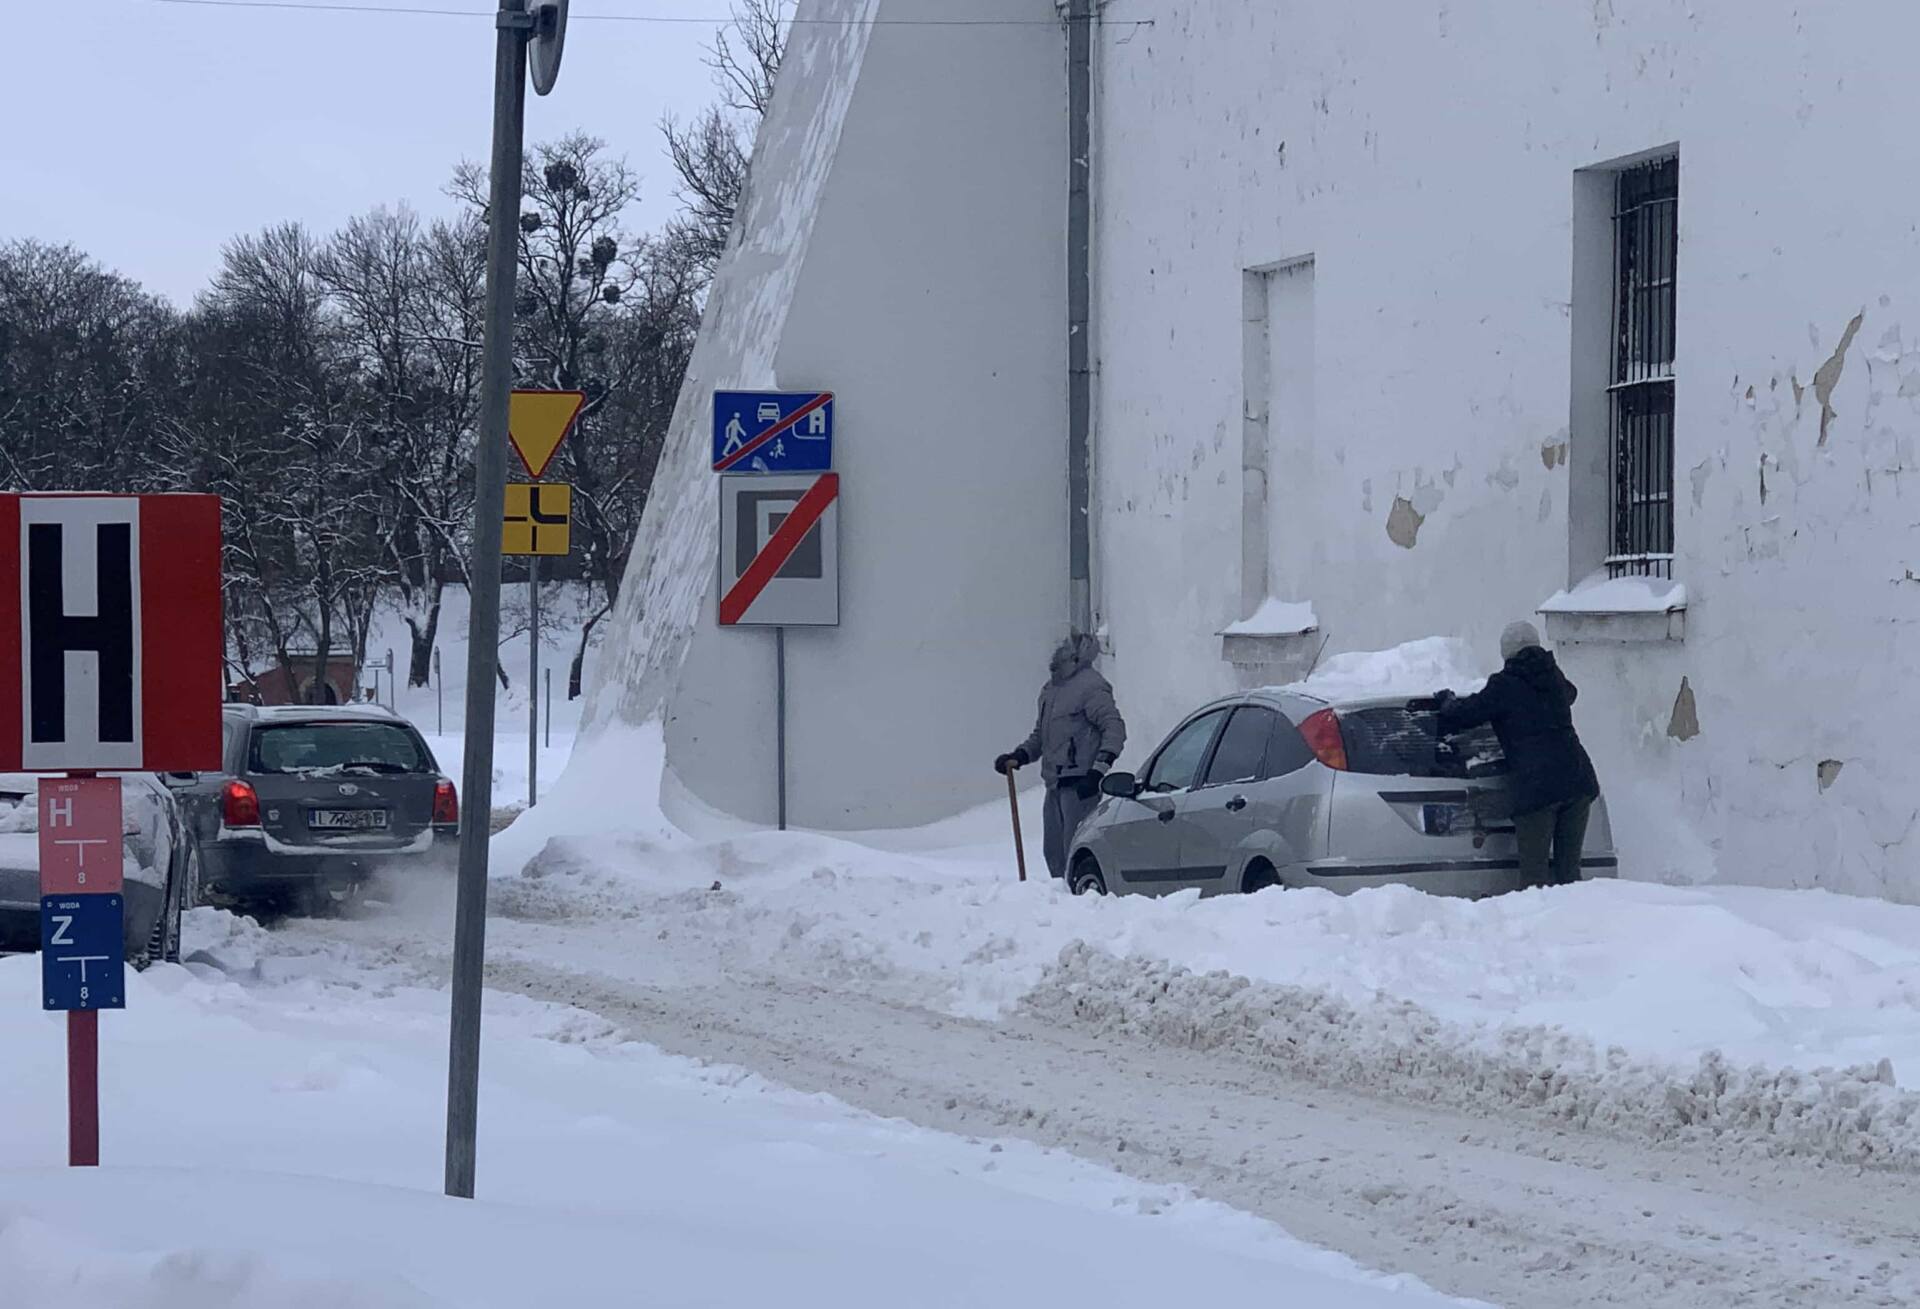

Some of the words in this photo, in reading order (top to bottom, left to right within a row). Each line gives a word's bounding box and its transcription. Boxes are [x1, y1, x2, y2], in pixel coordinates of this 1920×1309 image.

[28, 523, 134, 742] H
[49, 798, 72, 827] H
[78, 871, 86, 884] 8
[59, 902, 80, 910] WODA
[51, 915, 74, 945] Z
[80, 987, 89, 1000] 8
